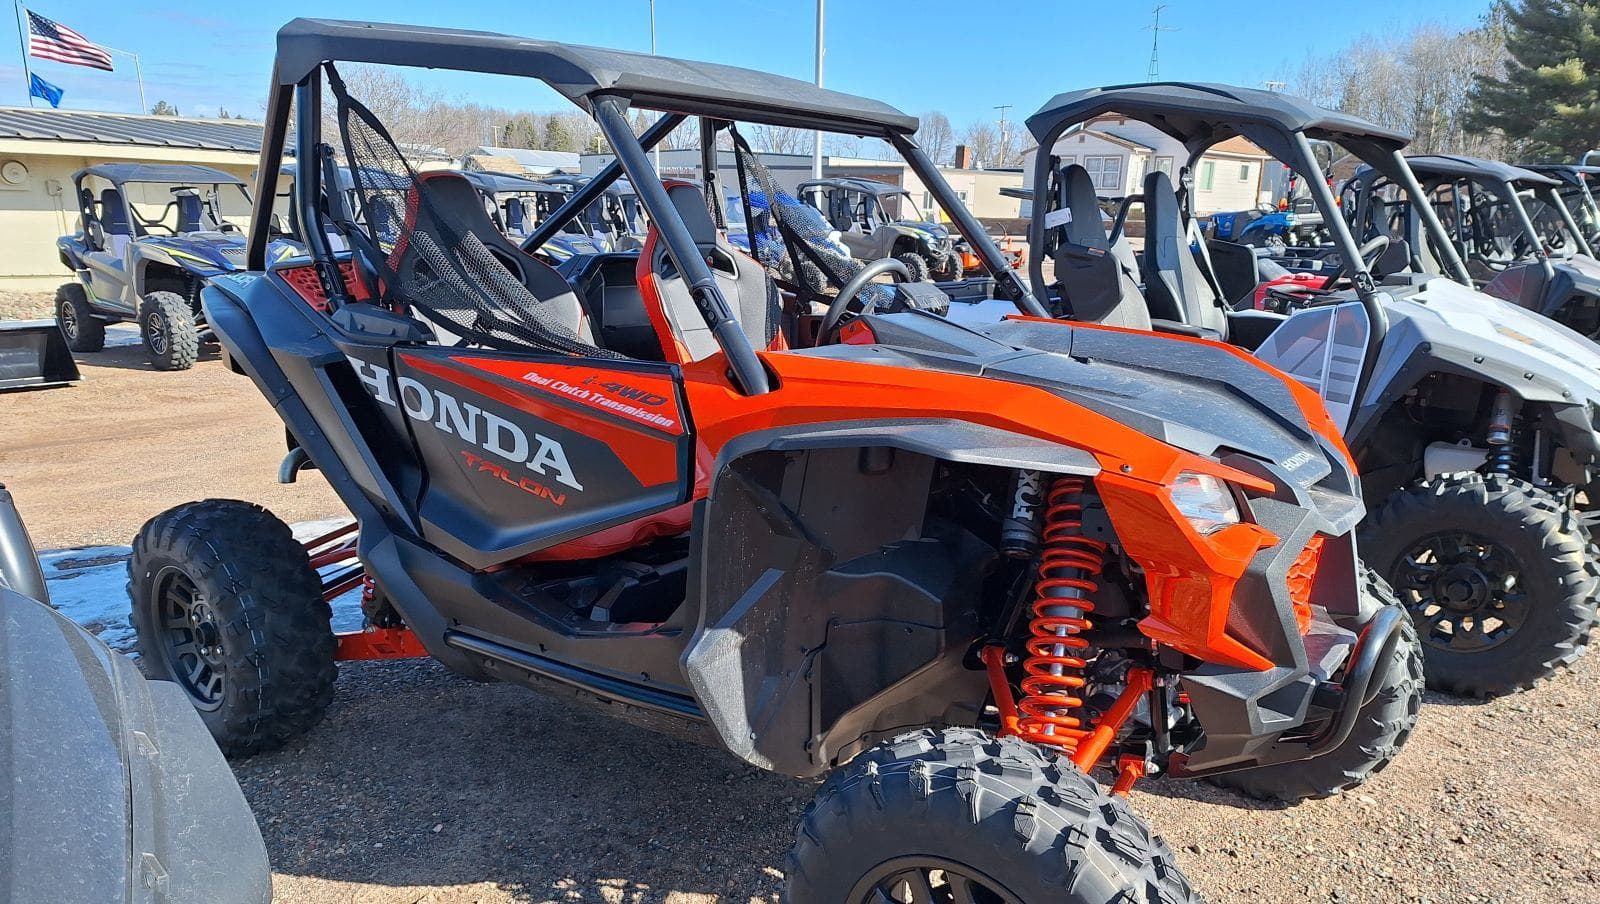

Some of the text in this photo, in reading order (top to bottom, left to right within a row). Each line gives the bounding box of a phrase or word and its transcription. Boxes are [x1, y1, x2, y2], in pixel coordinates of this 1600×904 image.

[345, 354, 584, 492] HONDA
[523, 371, 675, 427] Dual Clutch Transmission
[461, 450, 567, 507] TALON
[1281, 451, 1316, 471] HONDA
[1012, 469, 1040, 521] FOX
